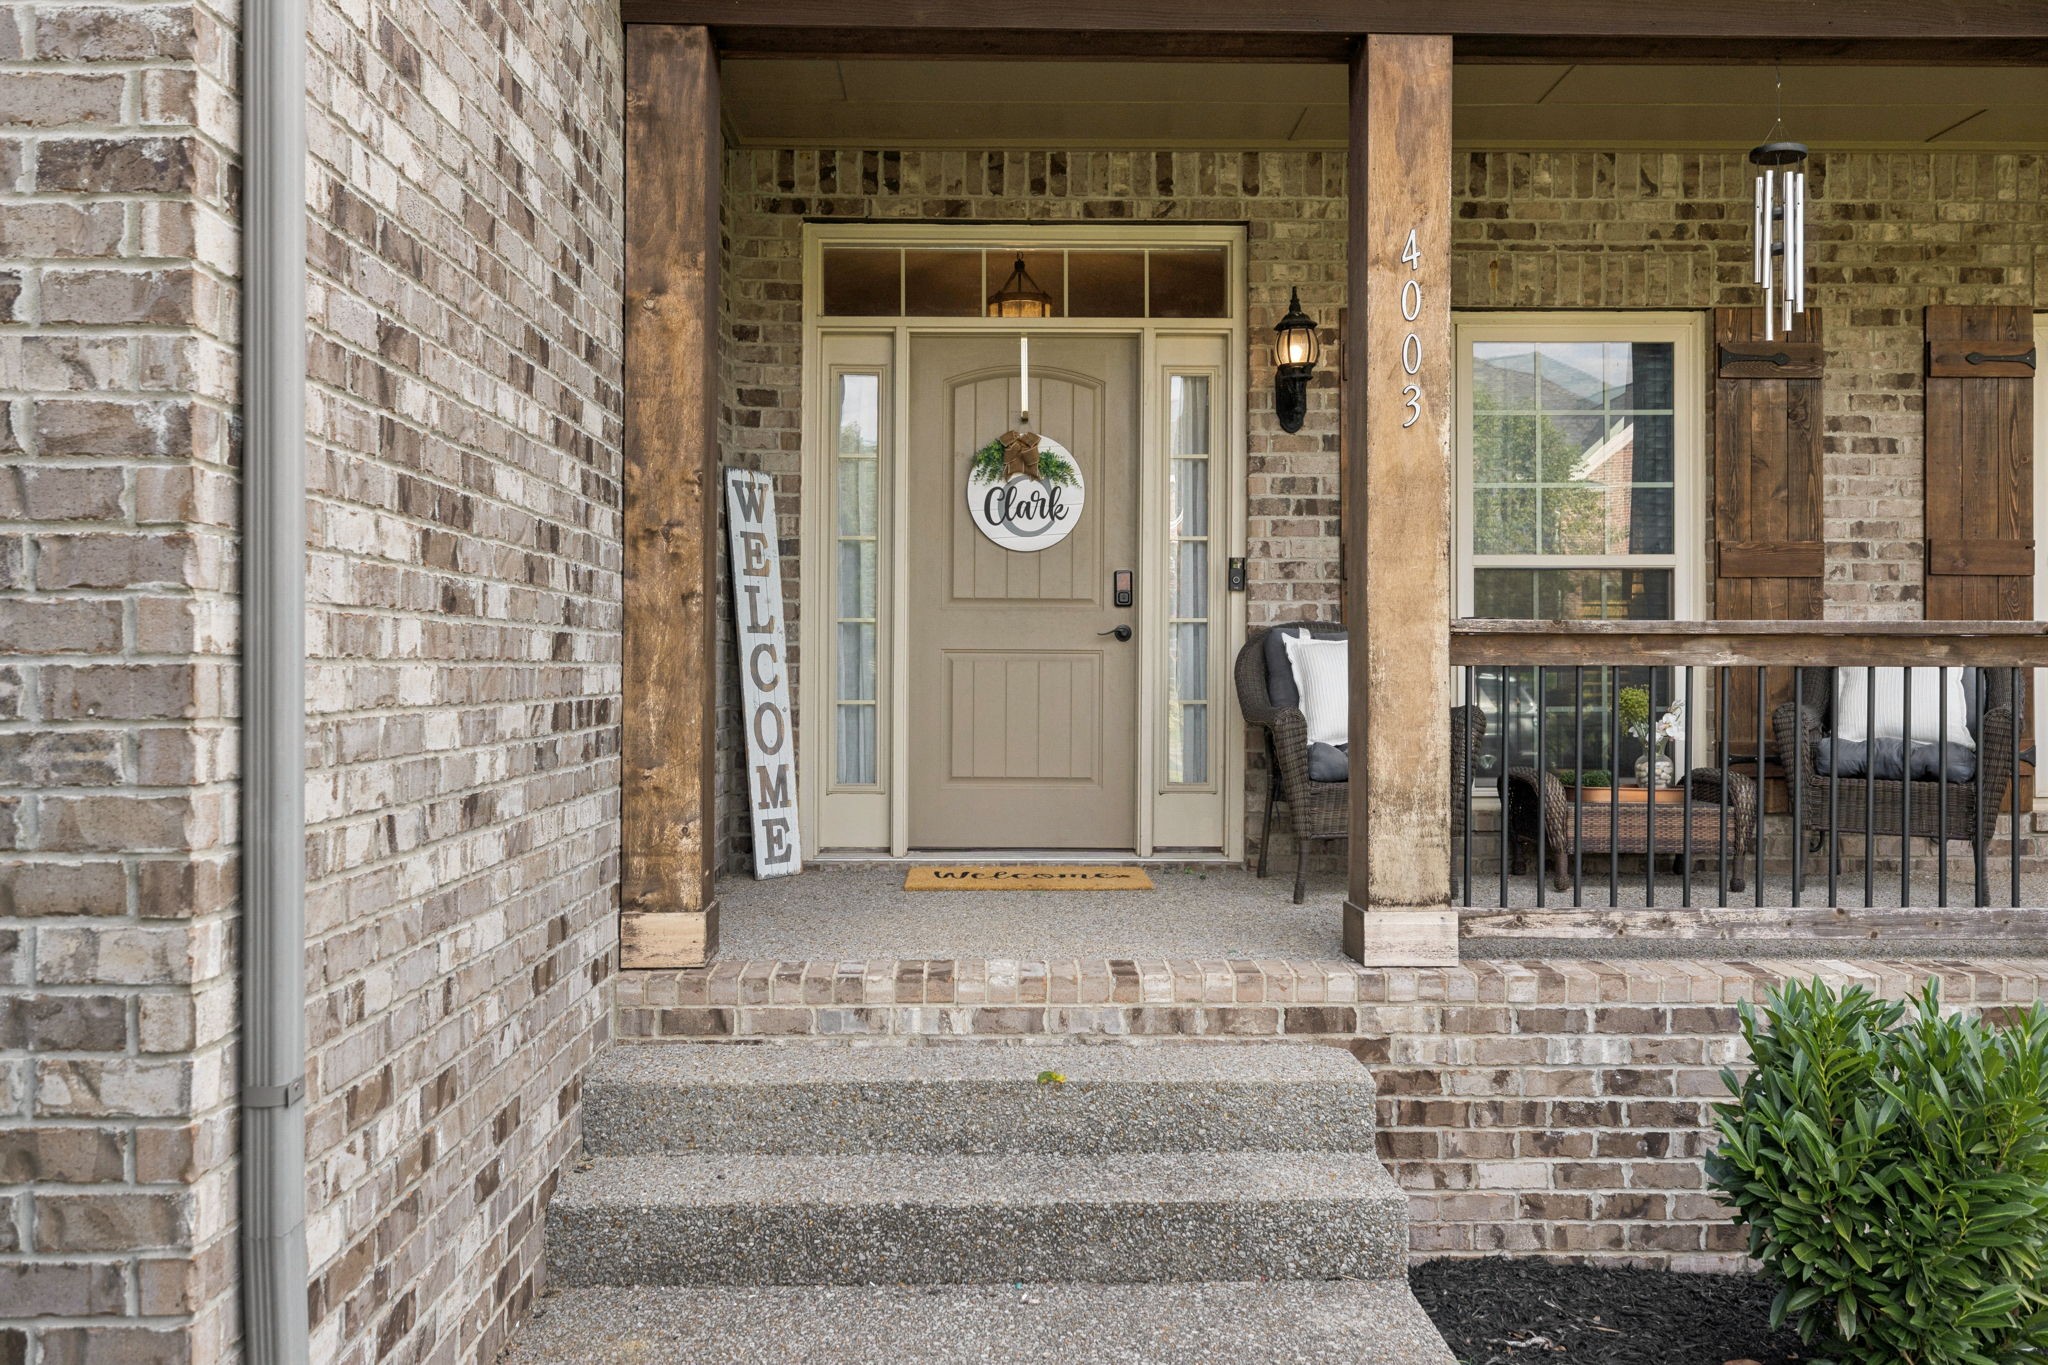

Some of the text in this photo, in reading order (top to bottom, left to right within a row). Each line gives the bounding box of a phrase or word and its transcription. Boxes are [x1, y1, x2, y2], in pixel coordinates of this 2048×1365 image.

[1401, 228, 1421, 428] 4003
[984, 486, 1069, 526] Clark
[732, 479, 792, 865] WELCOME
